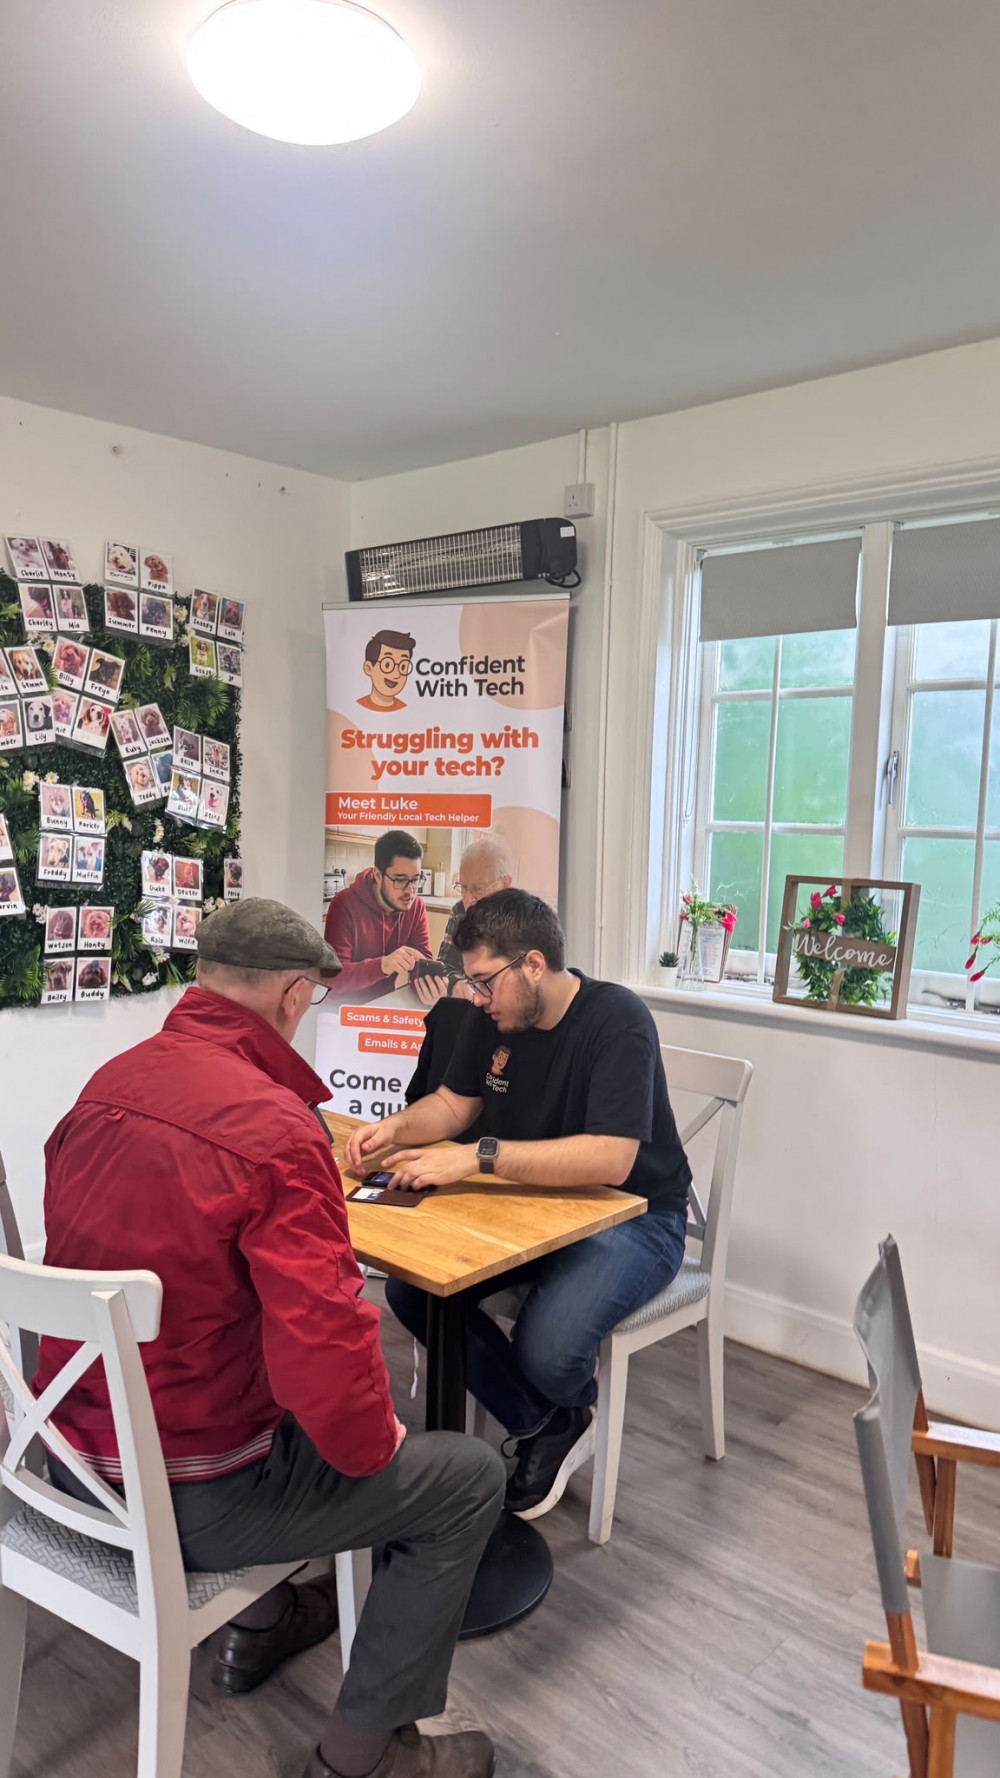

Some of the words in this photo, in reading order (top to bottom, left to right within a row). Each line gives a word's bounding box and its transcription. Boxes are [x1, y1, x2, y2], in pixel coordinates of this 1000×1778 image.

[147, 581, 166, 590] Pippa
[68, 621, 80, 629] Mia
[108, 617, 135, 629] Summer
[145, 626, 167, 637] Penny
[415, 655, 526, 676] Confident
[58, 672, 74, 685] Billy
[90, 683, 110, 697] Freya
[415, 678, 468, 698] With
[473, 677, 524, 697] Tech
[0, 737, 17, 746] mber
[35, 733, 47, 742] Lily
[340, 726, 474, 754] Struggling
[480, 725, 539, 749] with
[370, 759, 429, 781] your
[434, 755, 505, 777] tech?
[338, 796, 376, 810] Meet
[381, 796, 418, 810] Luke
[46, 816, 68, 827] Bunny
[337, 811, 357, 820] Your
[359, 812, 397, 822] Friendly
[399, 812, 422, 821] Local
[425, 813, 445, 821] Tech
[448, 813, 480, 823] Helper
[78, 821, 100, 830] Parker
[43, 868, 67, 879] Freddy
[76, 871, 99, 880] Muffin
[48, 942, 73, 950] Watson
[84, 941, 106, 950] Honey
[794, 933, 893, 969] Welcome
[47, 993, 67, 1002] Bailey
[81, 989, 104, 999] Buddy
[346, 1012, 381, 1023] Scams
[383, 1014, 390, 1023] &
[392, 1014, 425, 1028] Safety
[364, 1038, 398, 1049] Emails
[400, 1040, 408, 1050] &
[329, 1069, 402, 1093] Come
[348, 1099, 362, 1115] a
[370, 1101, 408, 1121] qu
